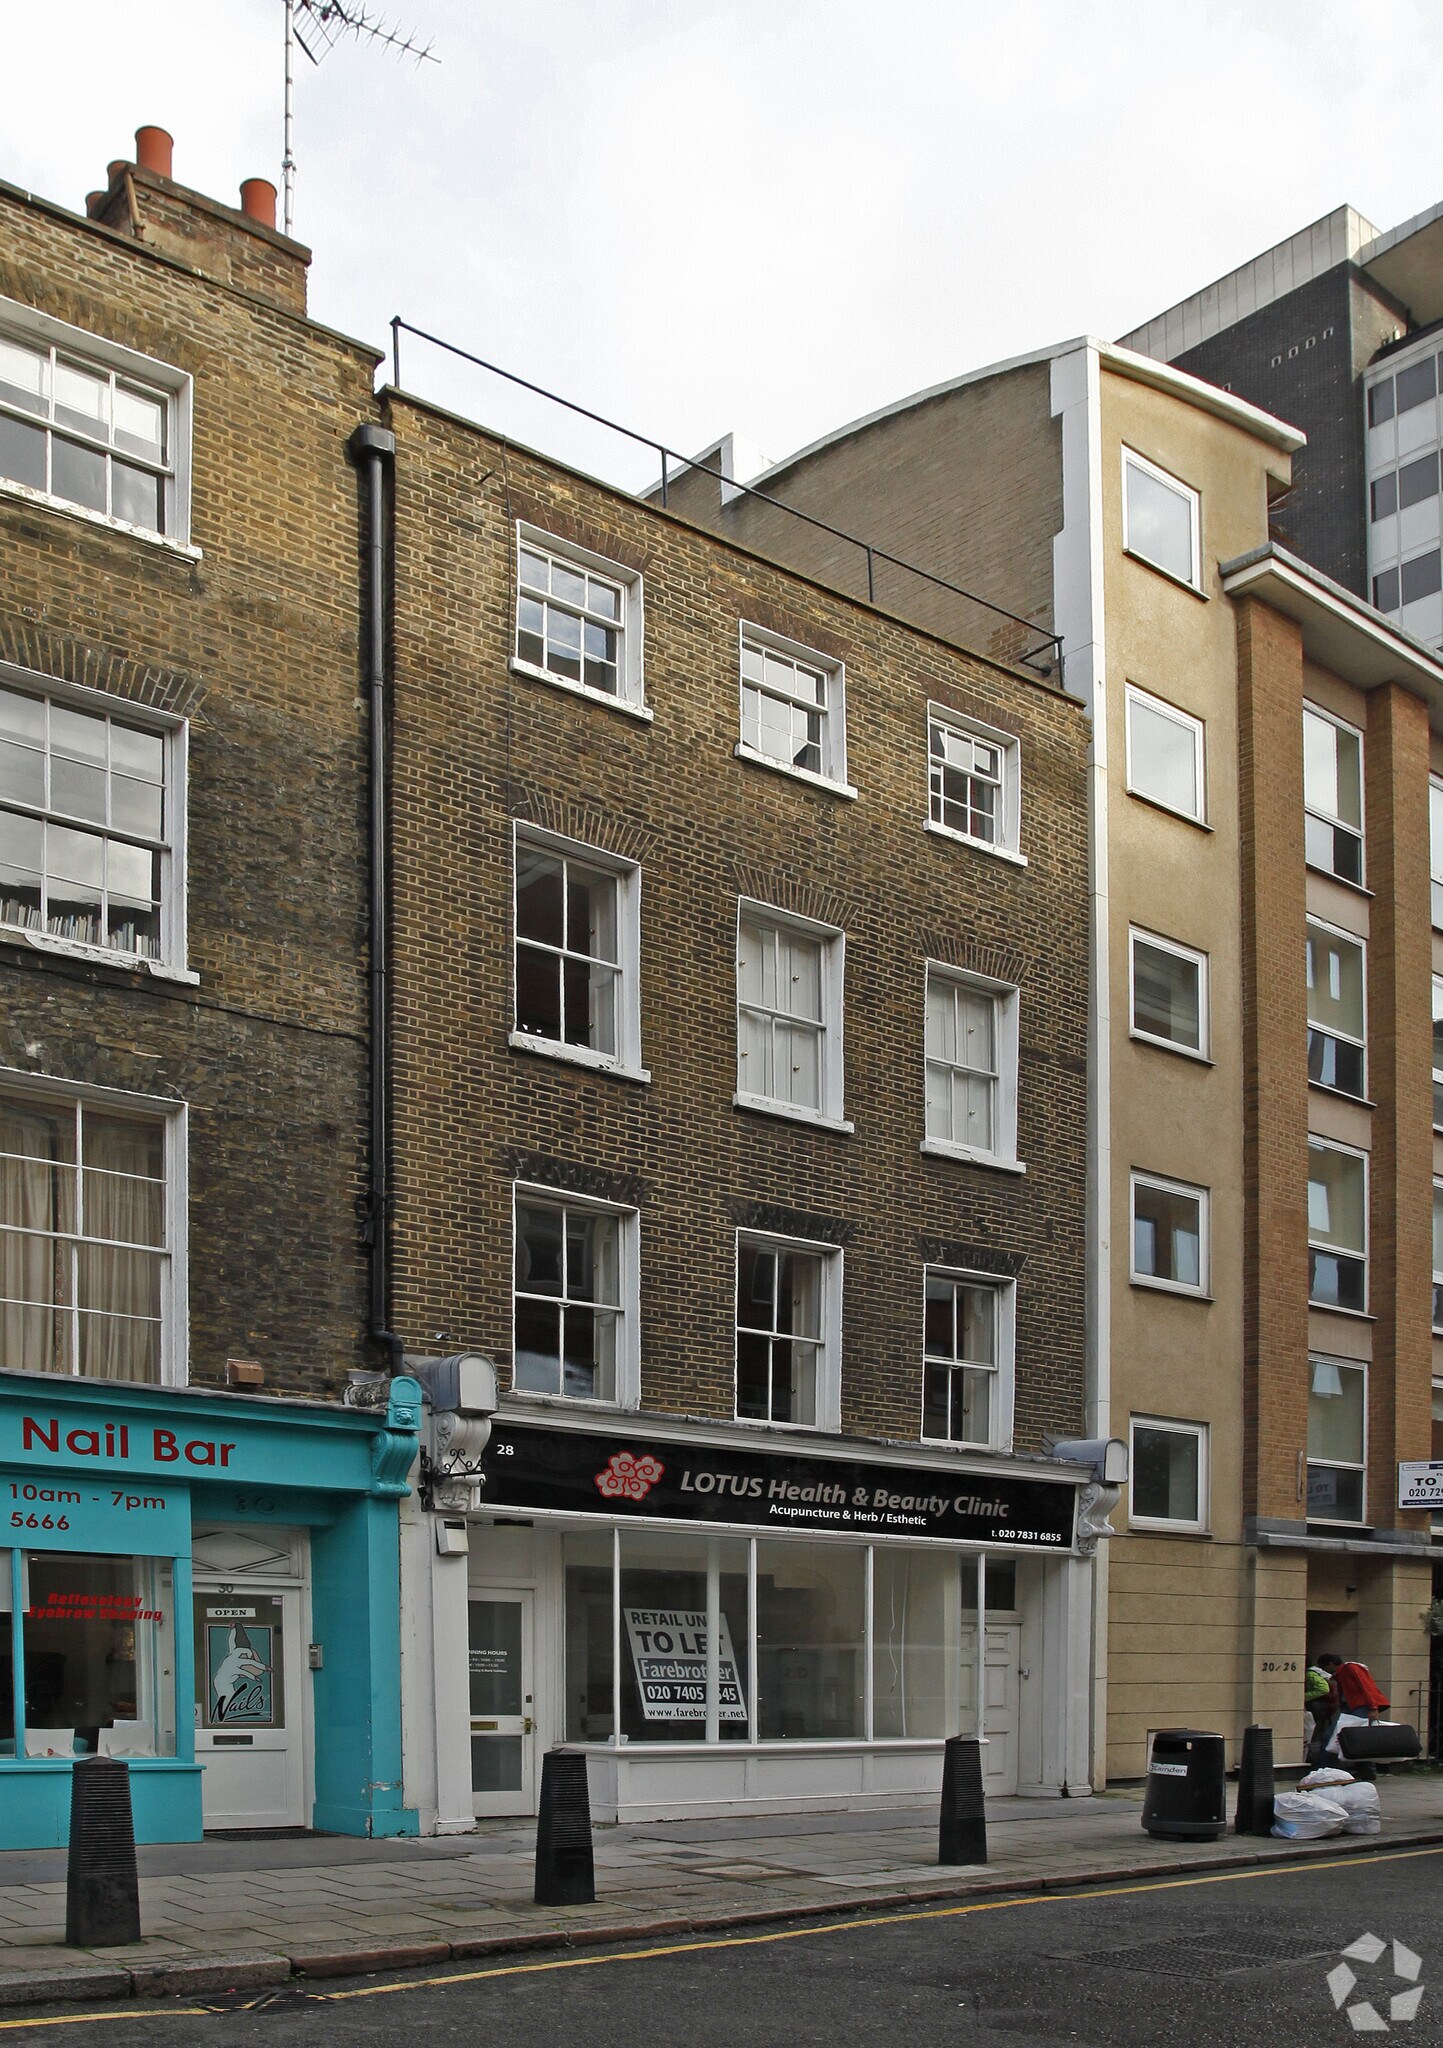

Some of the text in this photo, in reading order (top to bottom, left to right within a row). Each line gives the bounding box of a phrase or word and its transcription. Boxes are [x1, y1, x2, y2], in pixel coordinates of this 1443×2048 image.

[22, 1416, 237, 1467] Nail Bar
[496, 1444, 514, 1456] 28
[1413, 1477, 1437, 1486] TO
[9, 1483, 81, 1504] 10am
[111, 1490, 166, 1511] 7pm
[680, 1470, 1010, 1518] LOTUS Health & Beauty Clinic
[1408, 1488, 1427, 1497] 020
[9, 1511, 70, 1531] 5666
[769, 1504, 841, 1519] Acupuncture
[842, 1509, 851, 1520] &
[853, 1511, 879, 1522] Herb
[886, 1513, 927, 1526] Esthetic
[998, 1529, 1015, 1539] 020
[1017, 1531, 1038, 1541] 7831
[1040, 1532, 1062, 1542] 6855
[217, 1584, 234, 1594] 30
[47, 1592, 143, 1608] Reflexology
[28, 1604, 163, 1622] Eyebrow Shaping
[630, 1611, 707, 1628] RETAIL UN
[635, 1630, 674, 1654] TO
[640, 1659, 732, 1680] Farebroter
[646, 1685, 671, 1700] 020
[673, 1686, 704, 1701] 7405
[211, 1682, 266, 1724] Nails
[647, 1707, 746, 1719] www.farebroer.net
